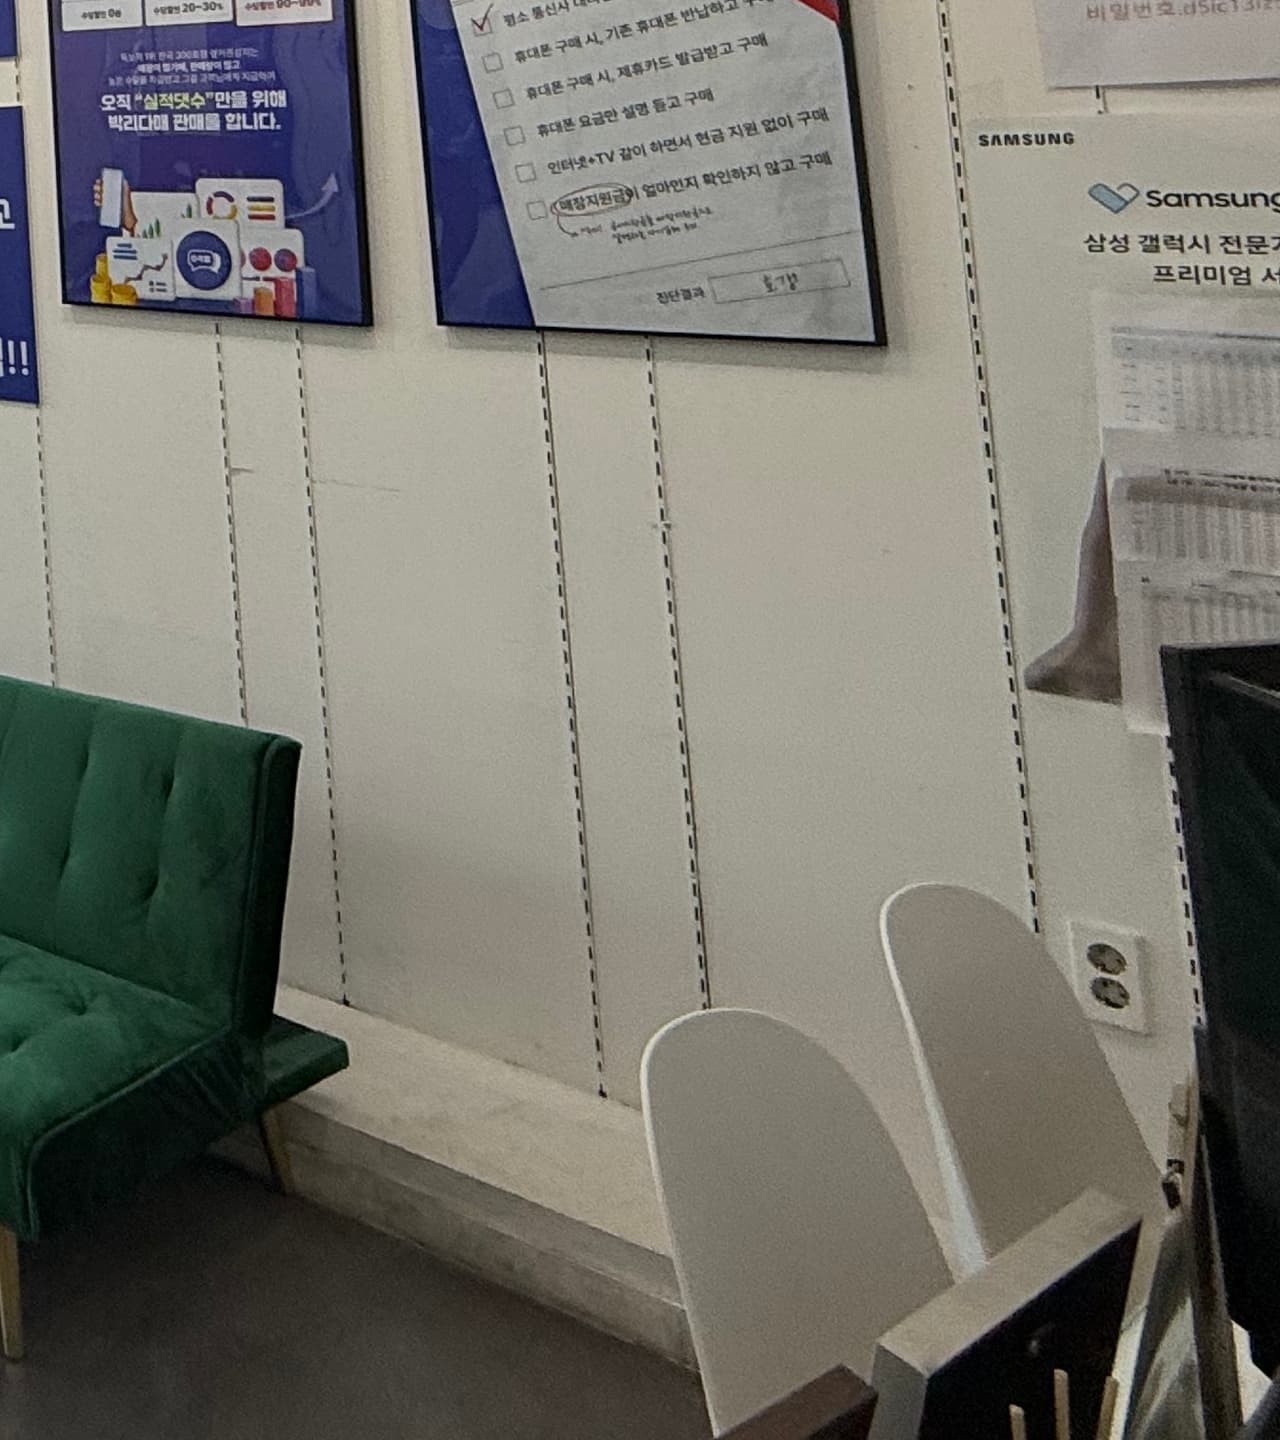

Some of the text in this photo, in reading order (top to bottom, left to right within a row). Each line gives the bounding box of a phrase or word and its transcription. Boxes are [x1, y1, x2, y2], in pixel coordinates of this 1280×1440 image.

[514, 41, 553, 64] 휴대폰
[555, 35, 582, 53] 구매
[606, 22, 634, 42] 기존
[635, 13, 679, 35] 휴대폰
[526, 79, 565, 101] 휴대폰
[566, 72, 594, 91] 구매
[617, 57, 674, 79] 제휴카드
[675, 41, 735, 66] 발급받고
[737, 32, 769, 53] 구매
[101, 94, 131, 111] 오직
[252, 89, 287, 108] 위해
[108, 112, 282, 132] 박리다매 판매를 합니다.
[537, 116, 577, 138] 휴대폰
[578, 106, 619, 129] 요금만
[684, 87, 715, 107] 구매
[650, 132, 692, 154] 하면서
[694, 126, 726, 146] 현금
[728, 120, 761, 141] 지원
[762, 114, 794, 135] 없이
[796, 107, 831, 128] 구매
[978, 131, 1075, 148] SAMSUNG
[641, 174, 700, 199] 얼마인지
[702, 162, 762, 186] 확인하지
[765, 157, 796, 177] 않고
[798, 150, 833, 171] 구매
[1083, 233, 1130, 254] 삼성
[1138, 233, 1210, 255] 갤럭시
[1153, 265, 1252, 287] 프리미엄
[656, 285, 706, 305] 진단결과
